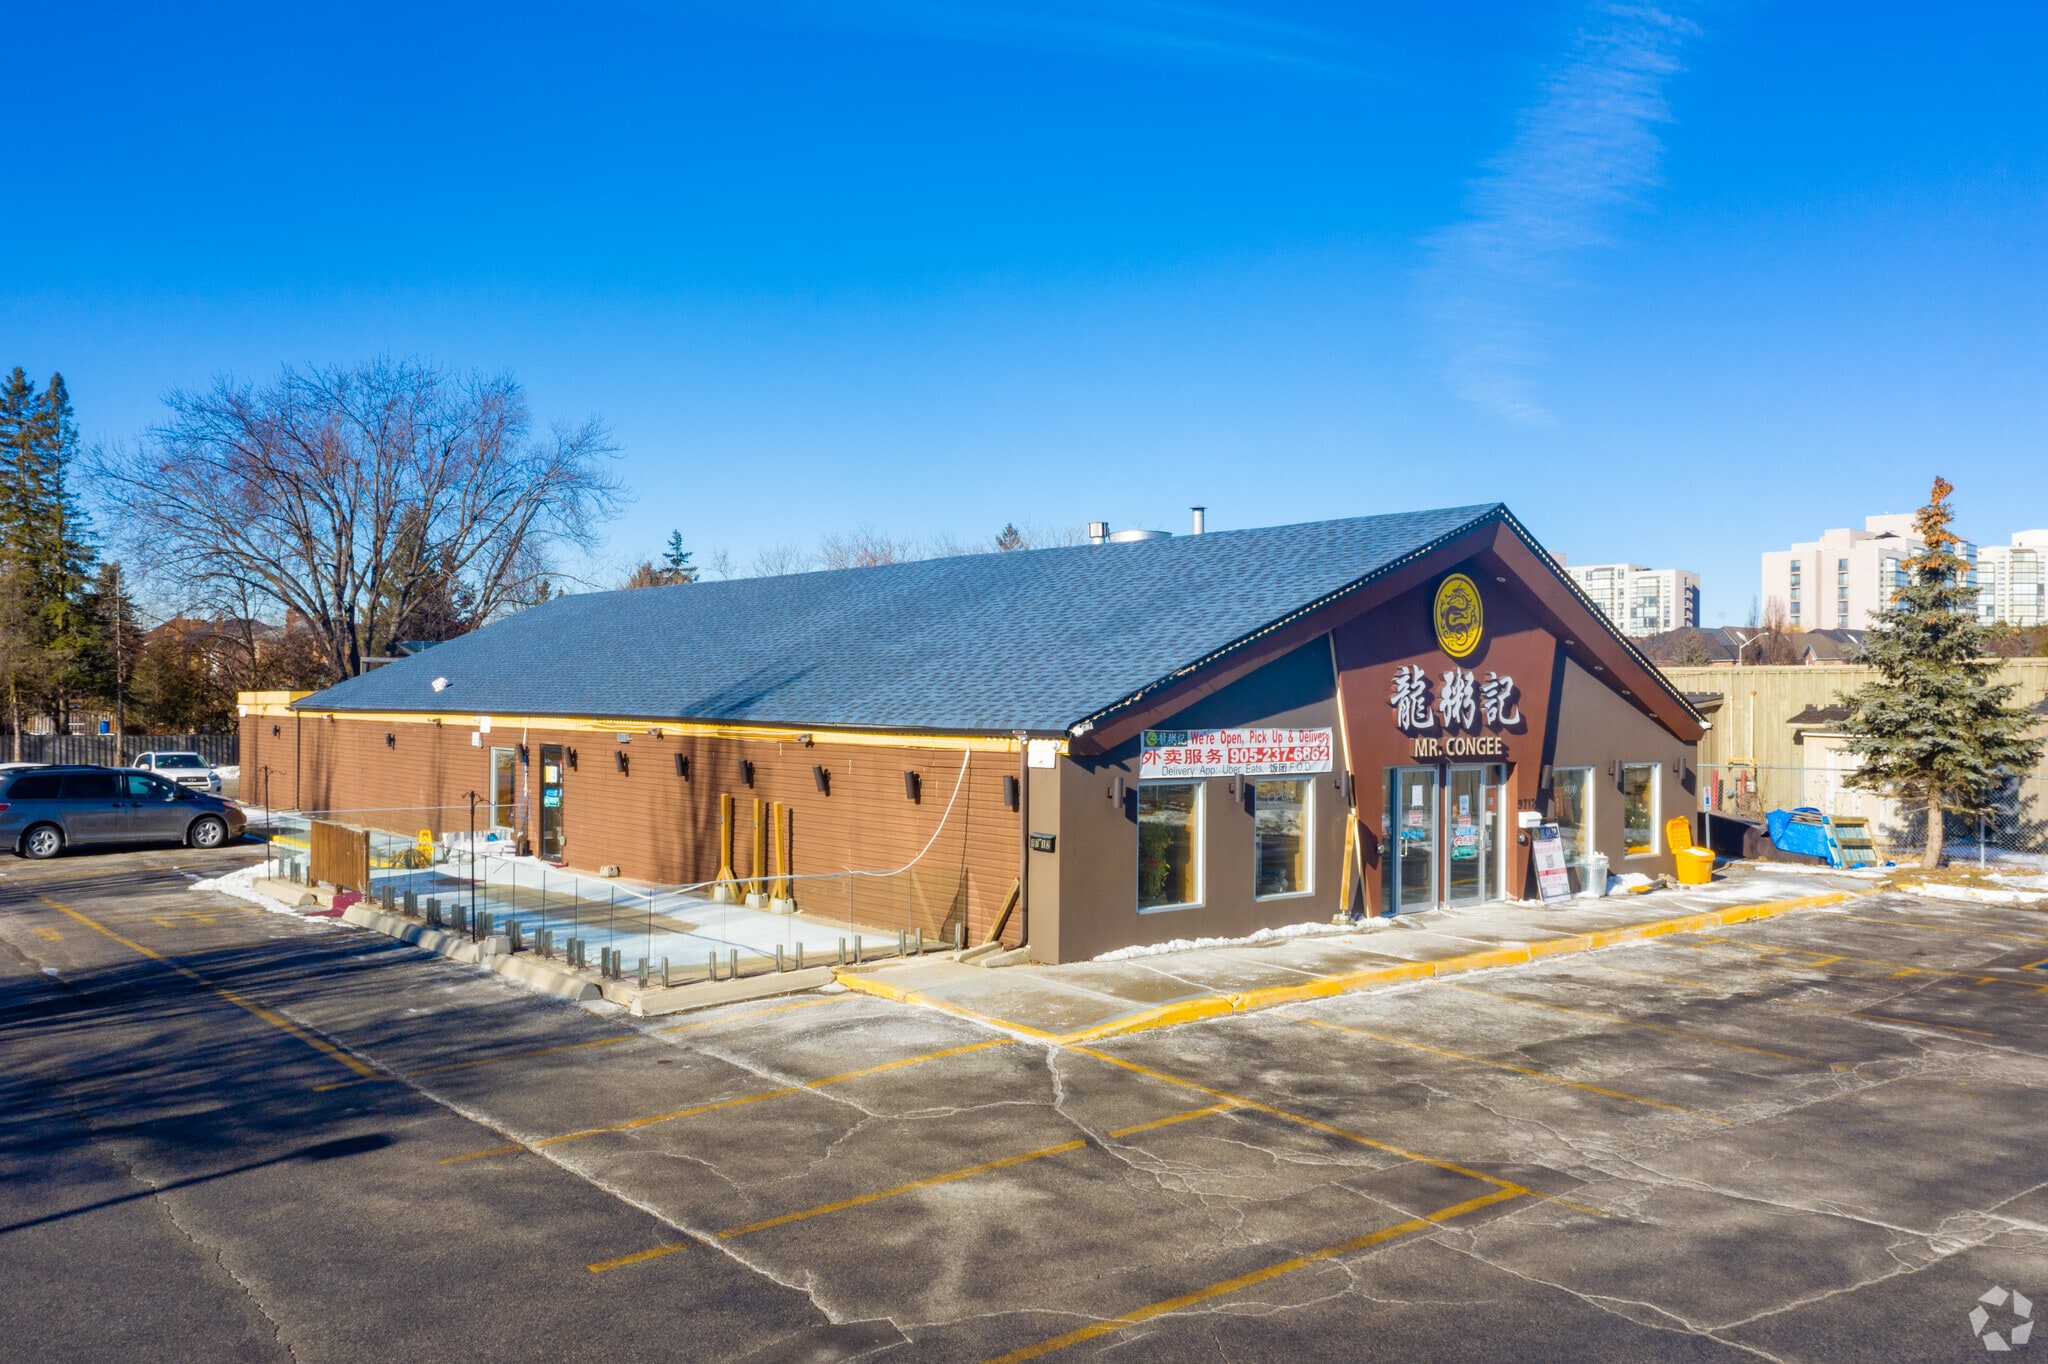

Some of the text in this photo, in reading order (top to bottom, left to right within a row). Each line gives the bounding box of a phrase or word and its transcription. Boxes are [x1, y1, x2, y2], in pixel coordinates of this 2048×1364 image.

[1390, 664, 1520, 730] 龍粥記
[1190, 729, 1330, 747] We're Open, Pick Up & Delivery
[1230, 746, 1328, 763] 905-237-6862
[1414, 737, 1502, 757] MR. CONGEE
[1142, 748, 1223, 765] 外卖服务
[1162, 766, 1195, 778] Delivery
[1200, 765, 1218, 776] App:
[1222, 764, 1241, 774] Uber
